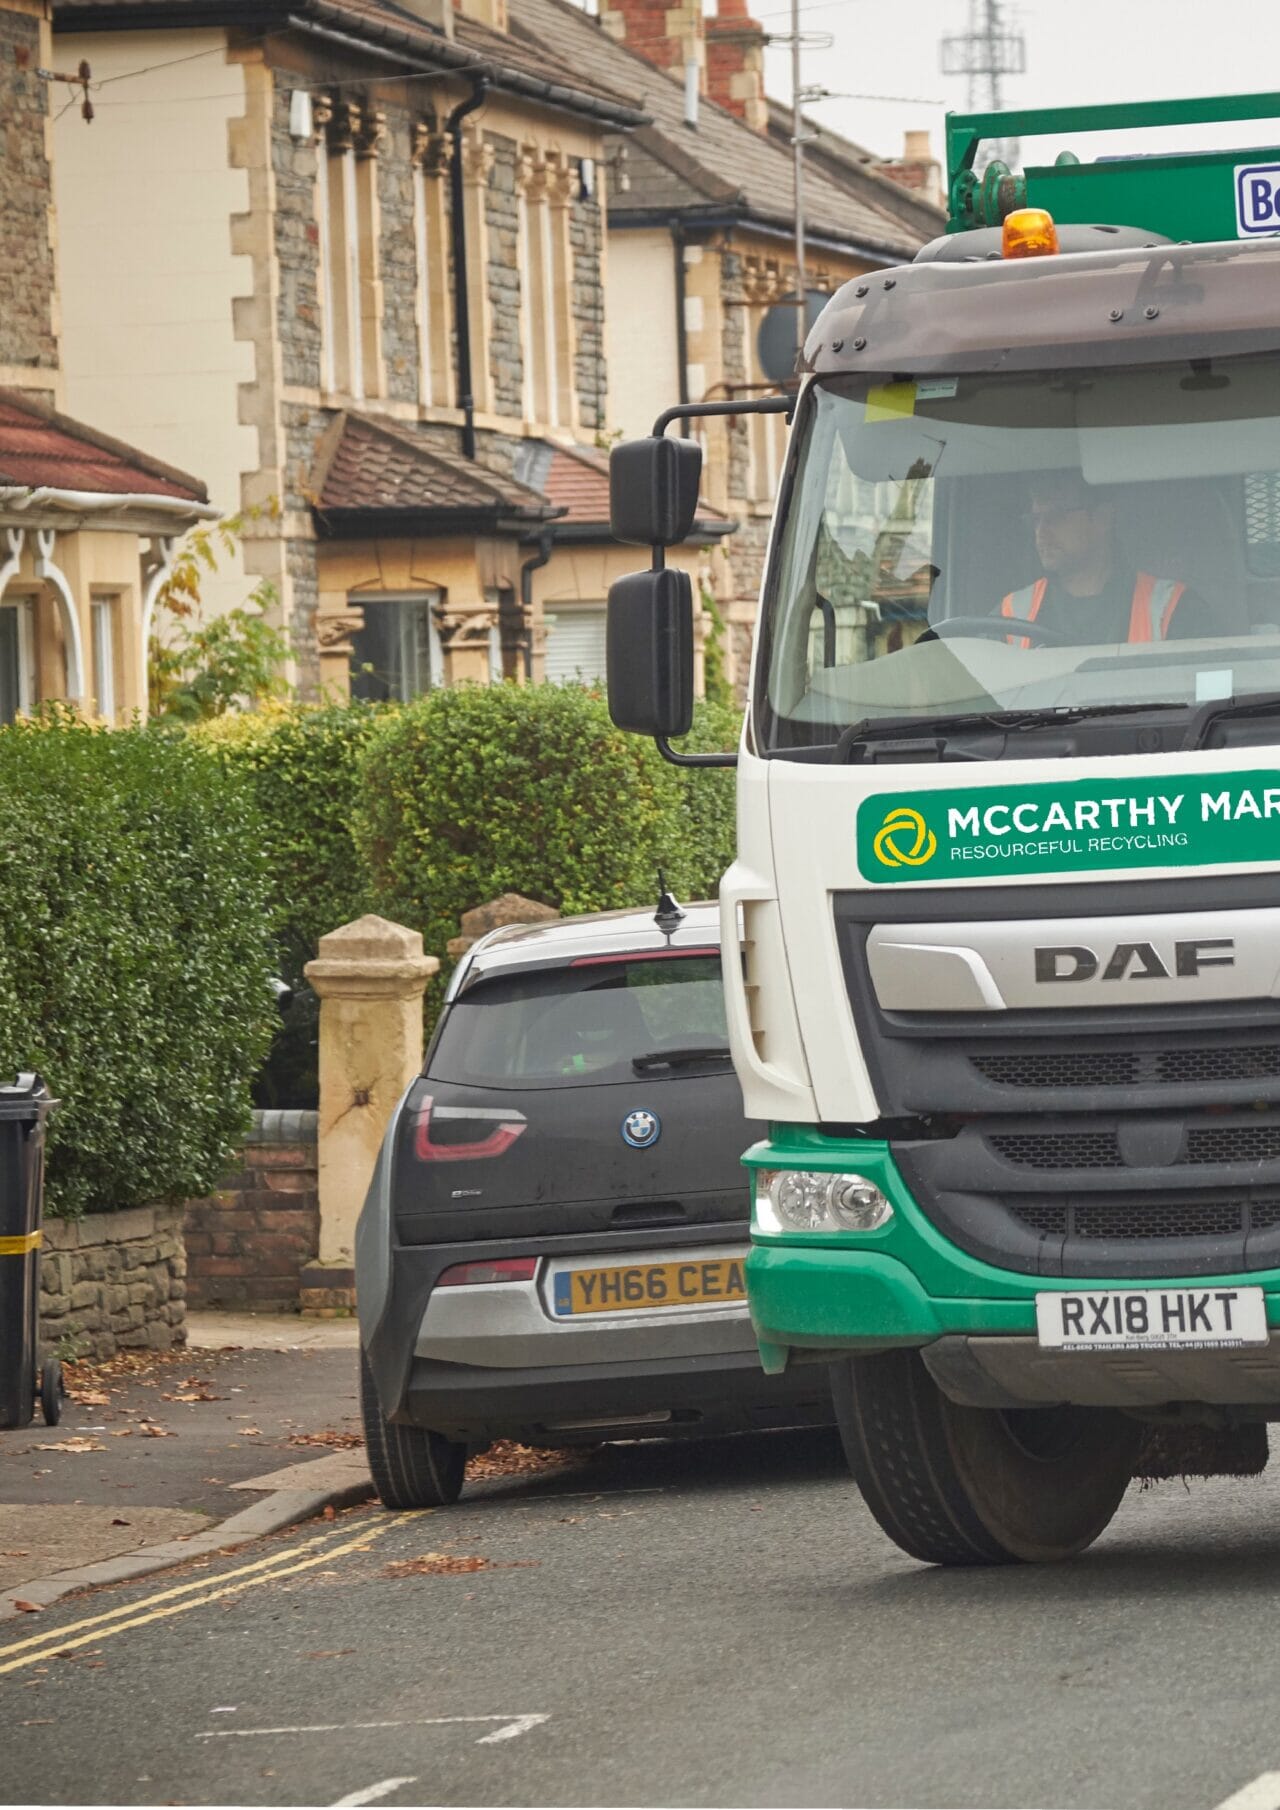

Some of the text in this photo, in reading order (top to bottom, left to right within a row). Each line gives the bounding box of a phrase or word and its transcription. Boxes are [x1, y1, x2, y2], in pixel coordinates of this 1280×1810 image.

[947, 795, 1186, 838] MCCARTHY
[950, 832, 1189, 861] RESOURCEFUL RECYCLING
[1033, 937, 1236, 984] DAF
[577, 1262, 746, 1305] YH66 CEA
[1060, 1292, 1239, 1336] RX18 HKT
